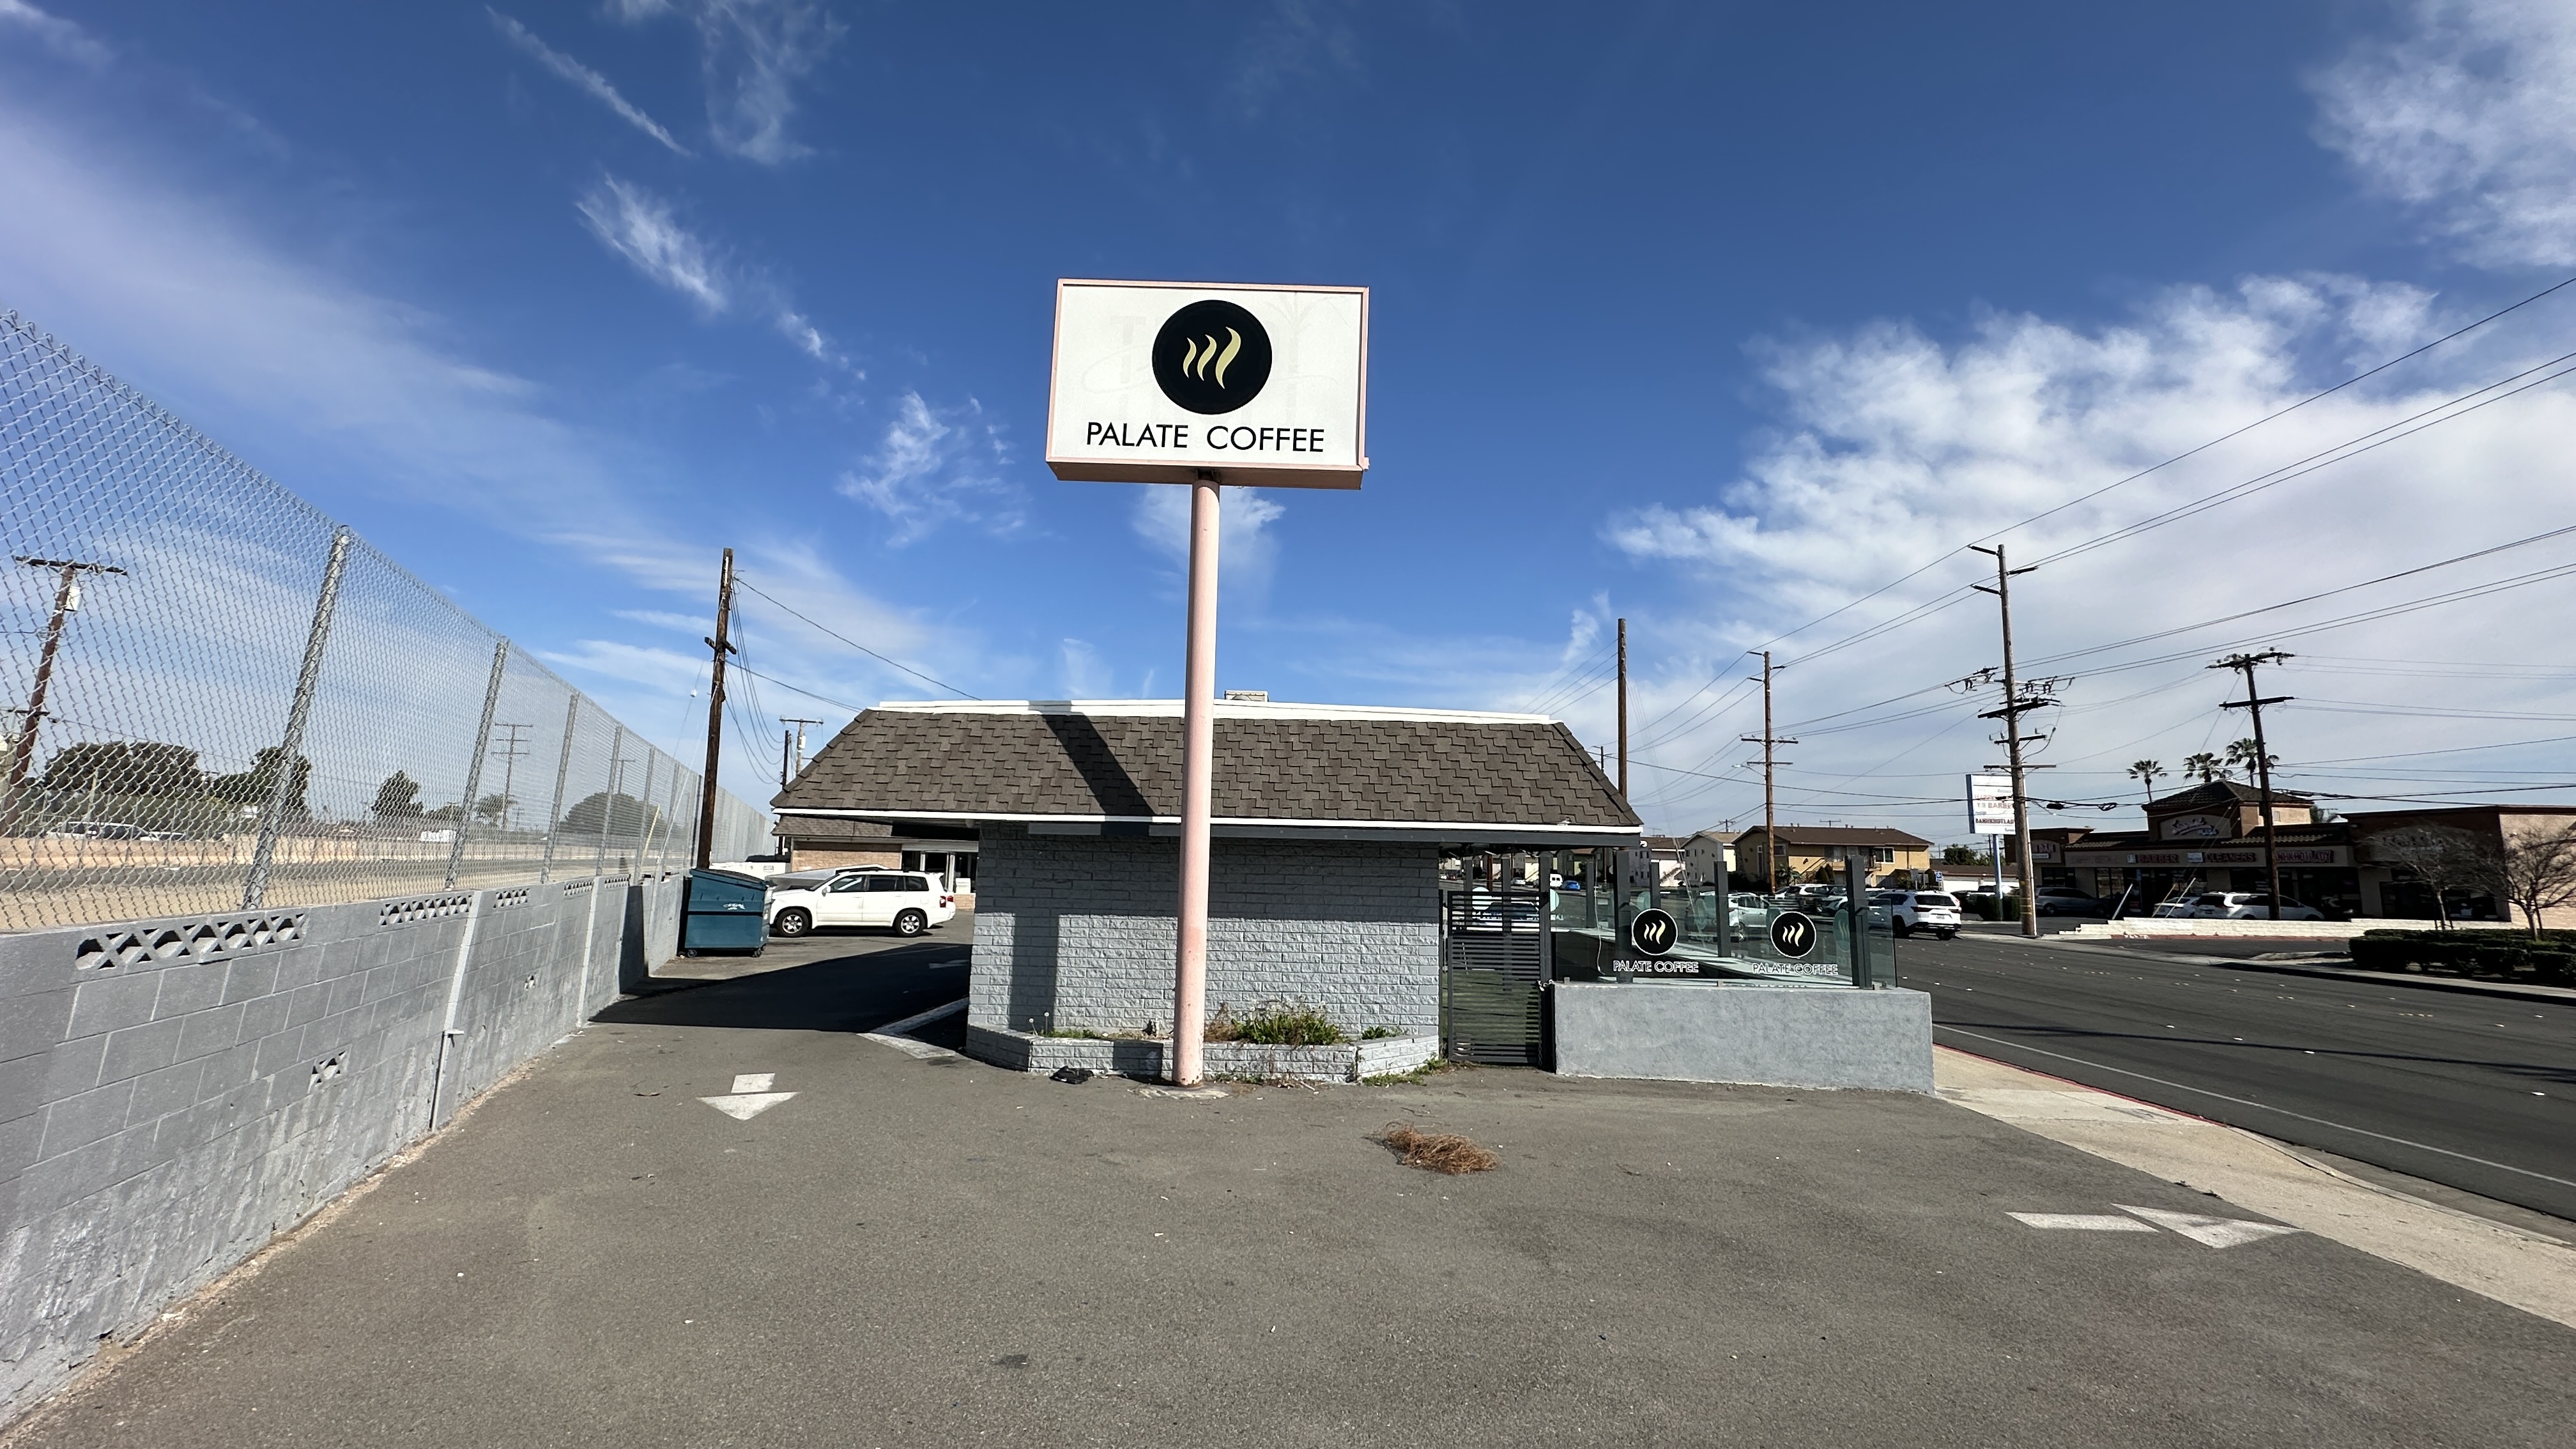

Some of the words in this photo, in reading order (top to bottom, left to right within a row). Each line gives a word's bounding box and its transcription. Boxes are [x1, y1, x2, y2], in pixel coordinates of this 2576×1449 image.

[1086, 422, 1188, 448] PALATE
[1207, 425, 1324, 452] COFFEE
[2138, 854, 2177, 863] BARBER
[2205, 852, 2255, 862] CLEANERS
[1613, 960, 1652, 972] PALATE
[1654, 961, 1699, 973] COFFEE
[1752, 963, 1791, 975] PALATE
[1793, 963, 1839, 976] COFFEE
